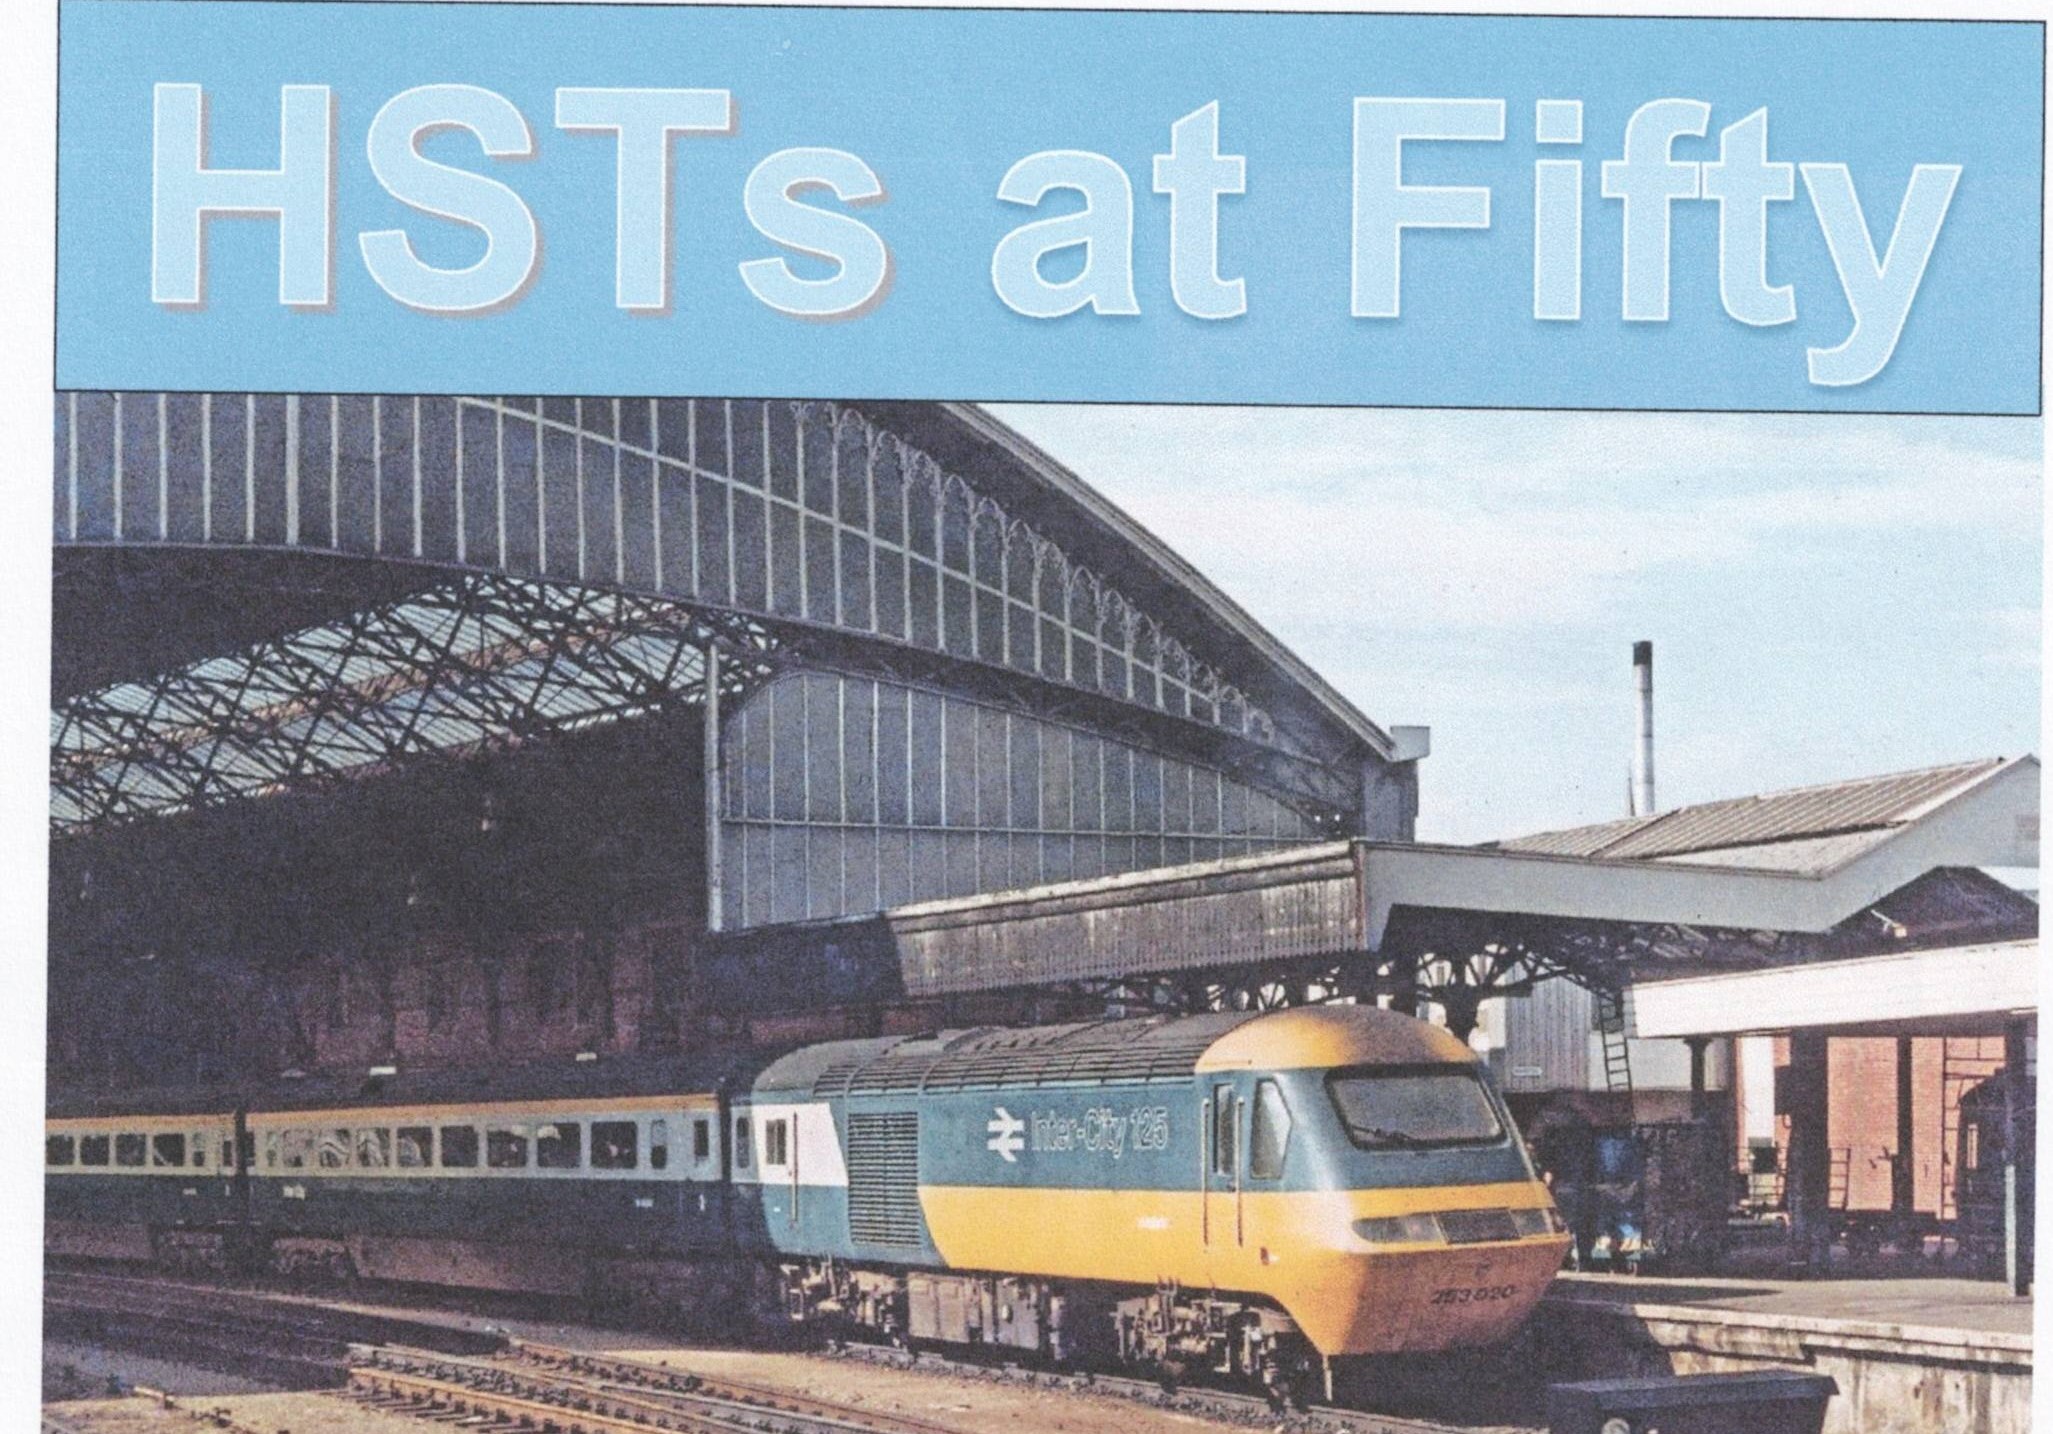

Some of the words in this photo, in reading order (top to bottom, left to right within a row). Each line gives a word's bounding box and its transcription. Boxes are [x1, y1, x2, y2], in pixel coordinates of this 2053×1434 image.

[151, 82, 891, 318] HSTs
[991, 100, 1249, 320] at
[1351, 97, 1965, 387] Fifty
[1030, 1107, 1127, 1159] Inter-City
[1130, 1106, 1169, 1150] 125
